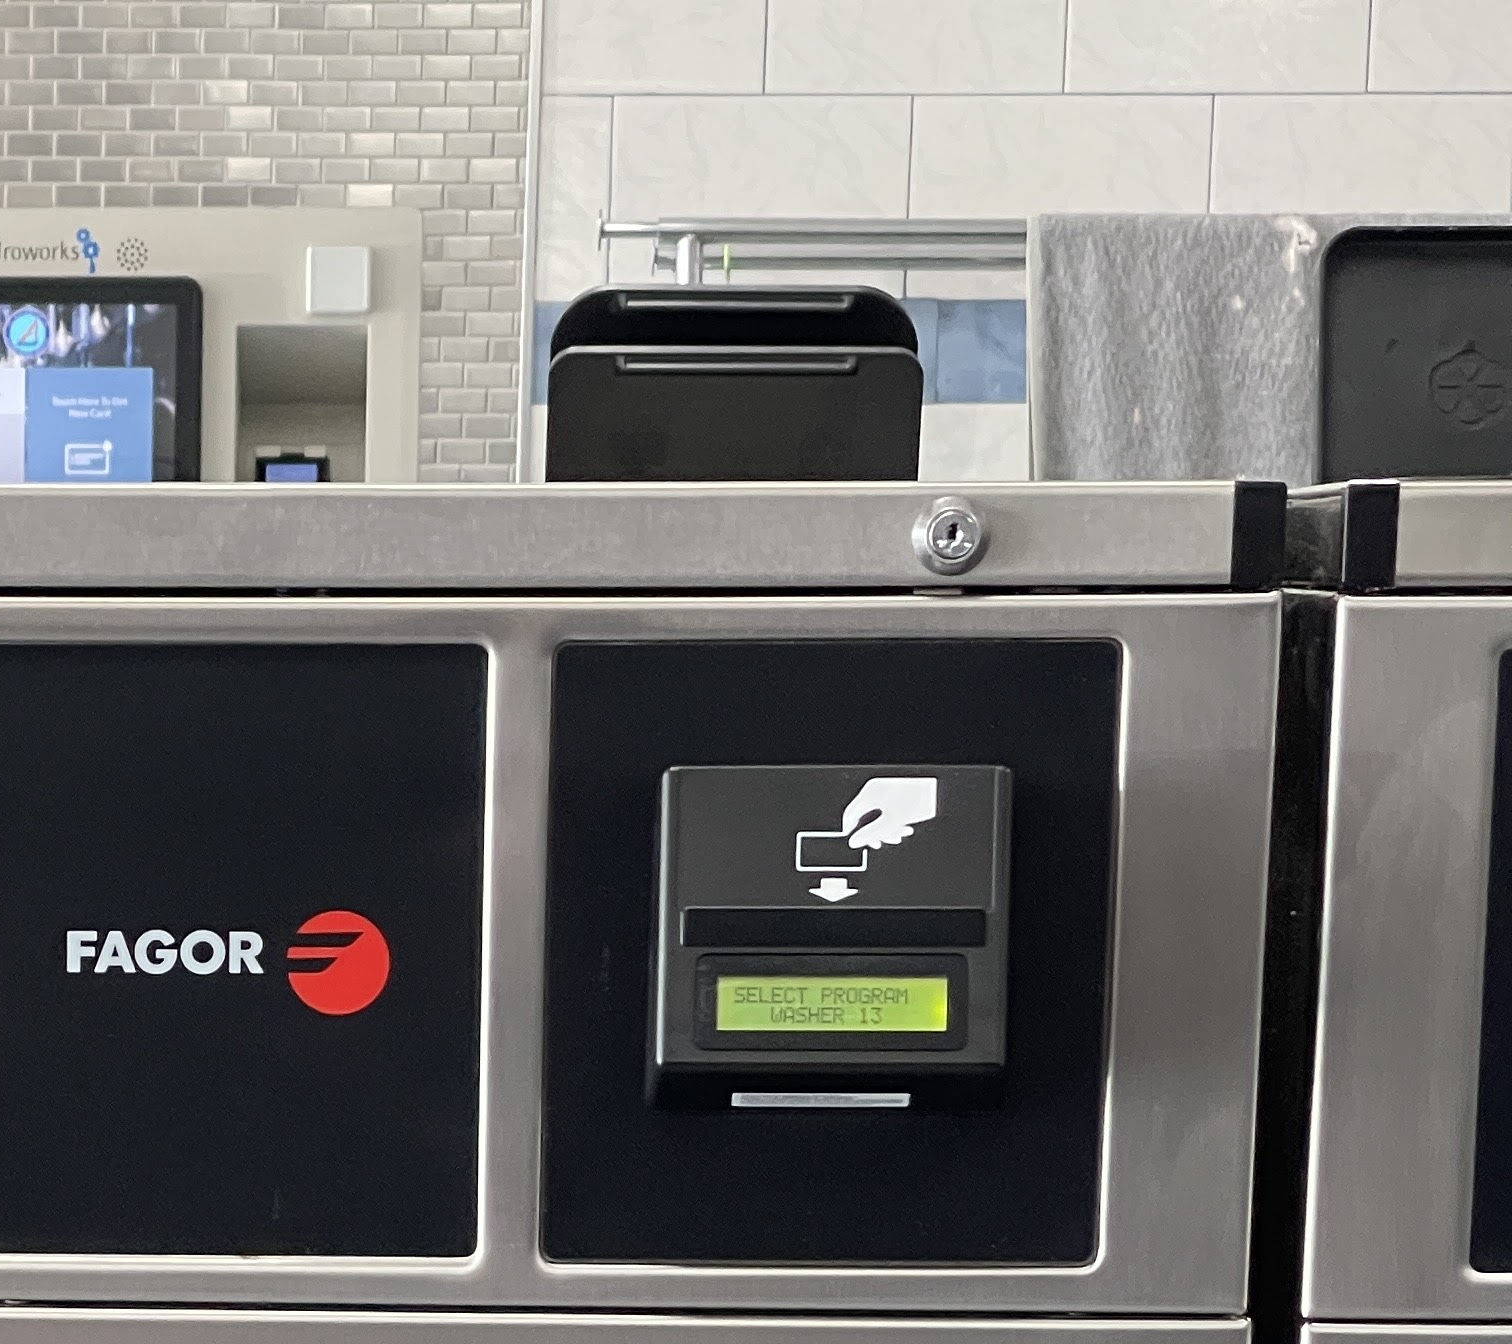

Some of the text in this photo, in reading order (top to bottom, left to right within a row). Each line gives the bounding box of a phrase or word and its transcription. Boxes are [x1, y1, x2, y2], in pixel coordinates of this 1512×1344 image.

[65, 929, 264, 975] FAGOR
[734, 987, 908, 1005] SELECT PROGRAM
[770, 1007, 883, 1024] WASHER 13
